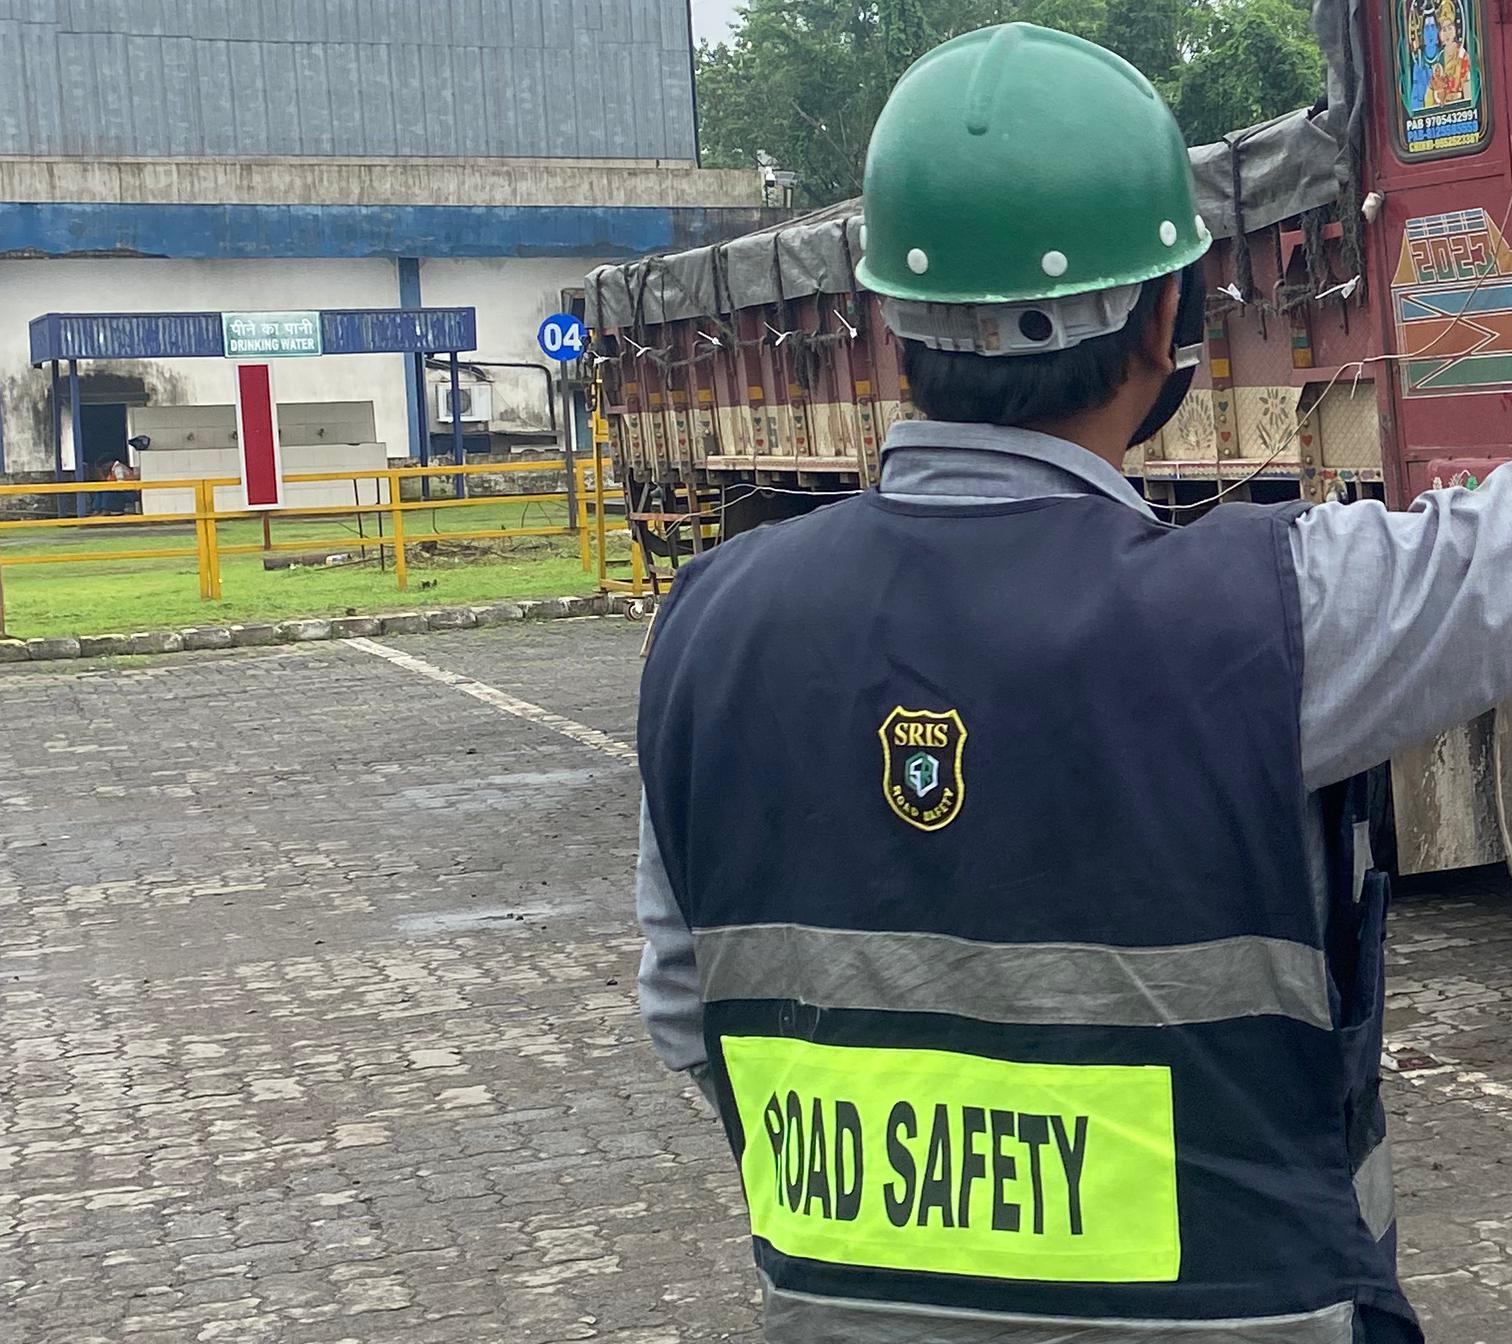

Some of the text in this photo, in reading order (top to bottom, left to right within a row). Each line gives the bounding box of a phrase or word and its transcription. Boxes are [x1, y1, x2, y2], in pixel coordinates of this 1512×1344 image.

[1406, 119, 1424, 131] PAB
[1410, 232, 1498, 284] 2023
[229, 318, 313, 337] पीने का पानी
[544, 323, 582, 352] 04
[230, 338, 315, 352] DRINKING WATER
[894, 722, 949, 748] SRIS
[764, 1090, 1089, 1236] ROAD SAFETY
